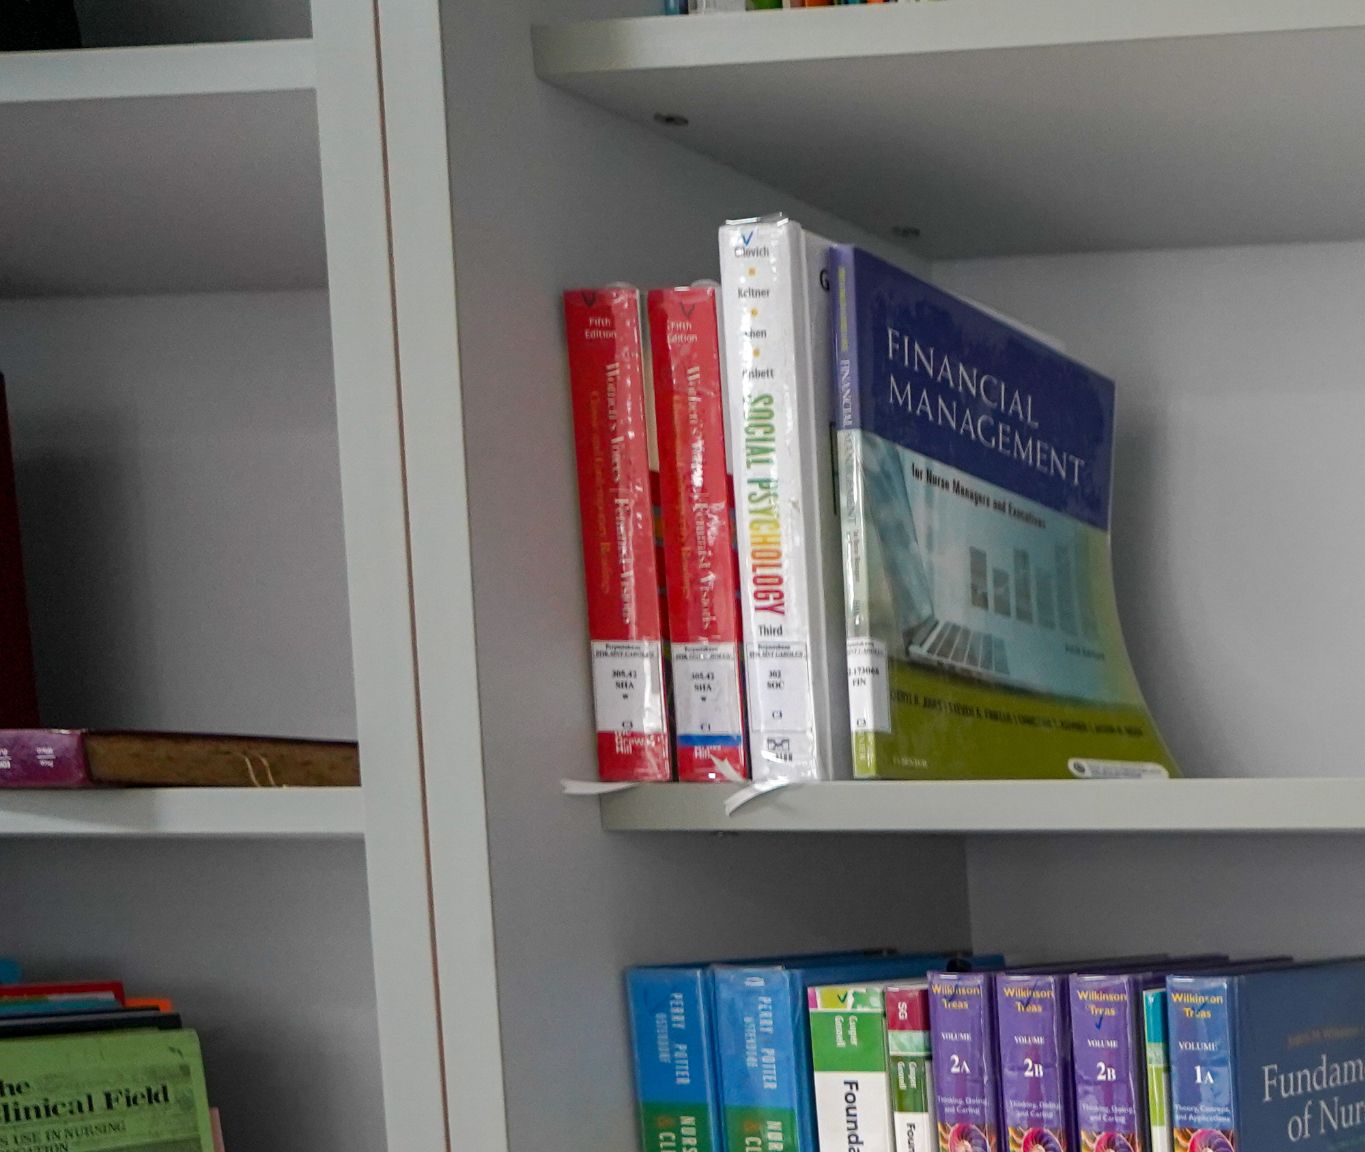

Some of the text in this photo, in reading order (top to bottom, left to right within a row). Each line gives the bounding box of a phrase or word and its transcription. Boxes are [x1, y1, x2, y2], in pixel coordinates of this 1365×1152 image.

[887, 327, 1039, 429] FINANCIAL
[890, 373, 1085, 487] MANAGEMENT
[744, 393, 786, 617] SOCIAL PSYCHOLOGY
[912, 463, 1046, 528] for Nurse Managers and Executives
[758, 625, 782, 636] Third
[1077, 990, 1127, 1002] Wilkinson
[950, 1055, 970, 1074] 2A
[1024, 1058, 1043, 1078] 2B
[1096, 1062, 1117, 1081] 2B
[1194, 1065, 1214, 1084] 1A
[104, 1083, 169, 1110] Field
[1287, 1100, 1312, 1142] of
